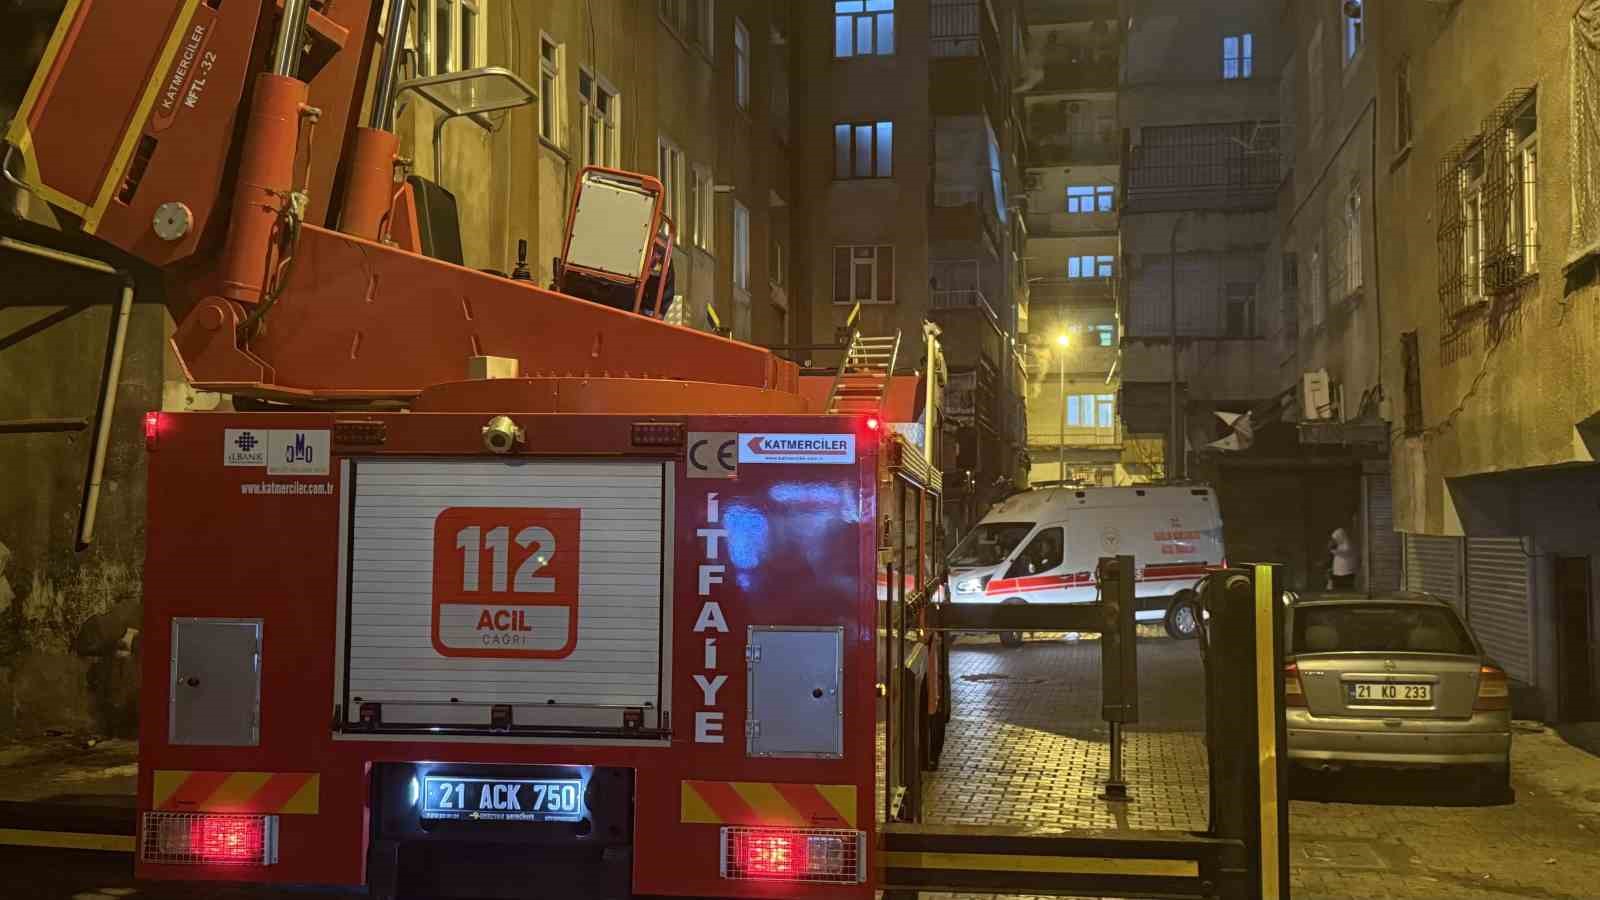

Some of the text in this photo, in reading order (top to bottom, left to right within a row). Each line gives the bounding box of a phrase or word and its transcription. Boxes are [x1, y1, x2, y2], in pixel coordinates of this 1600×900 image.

[689, 440, 736, 471] CE
[456, 525, 556, 593] 112
[1358, 686, 1371, 698] 21
[1405, 686, 1426, 699] 233
[439, 782, 575, 811] 21 ACK 750
